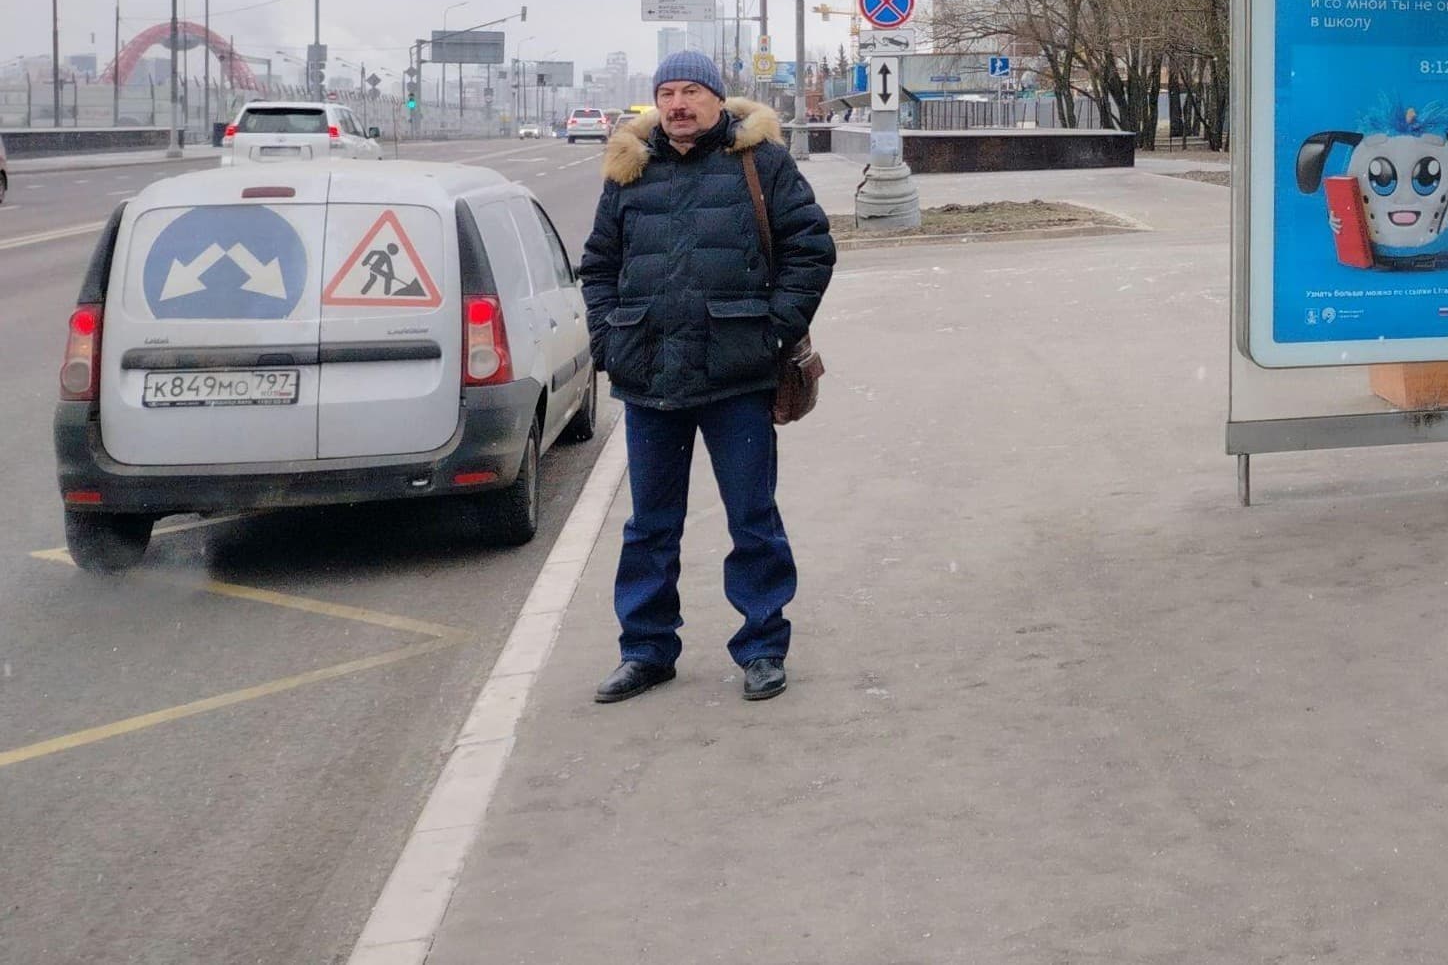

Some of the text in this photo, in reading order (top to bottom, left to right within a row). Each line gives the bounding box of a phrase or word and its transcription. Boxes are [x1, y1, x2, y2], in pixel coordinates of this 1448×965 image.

[1391, 0, 1410, 11] ты
[1414, 0, 1433, 12] не
[1310, 15, 1372, 31] в школу
[253, 373, 290, 390] 797
